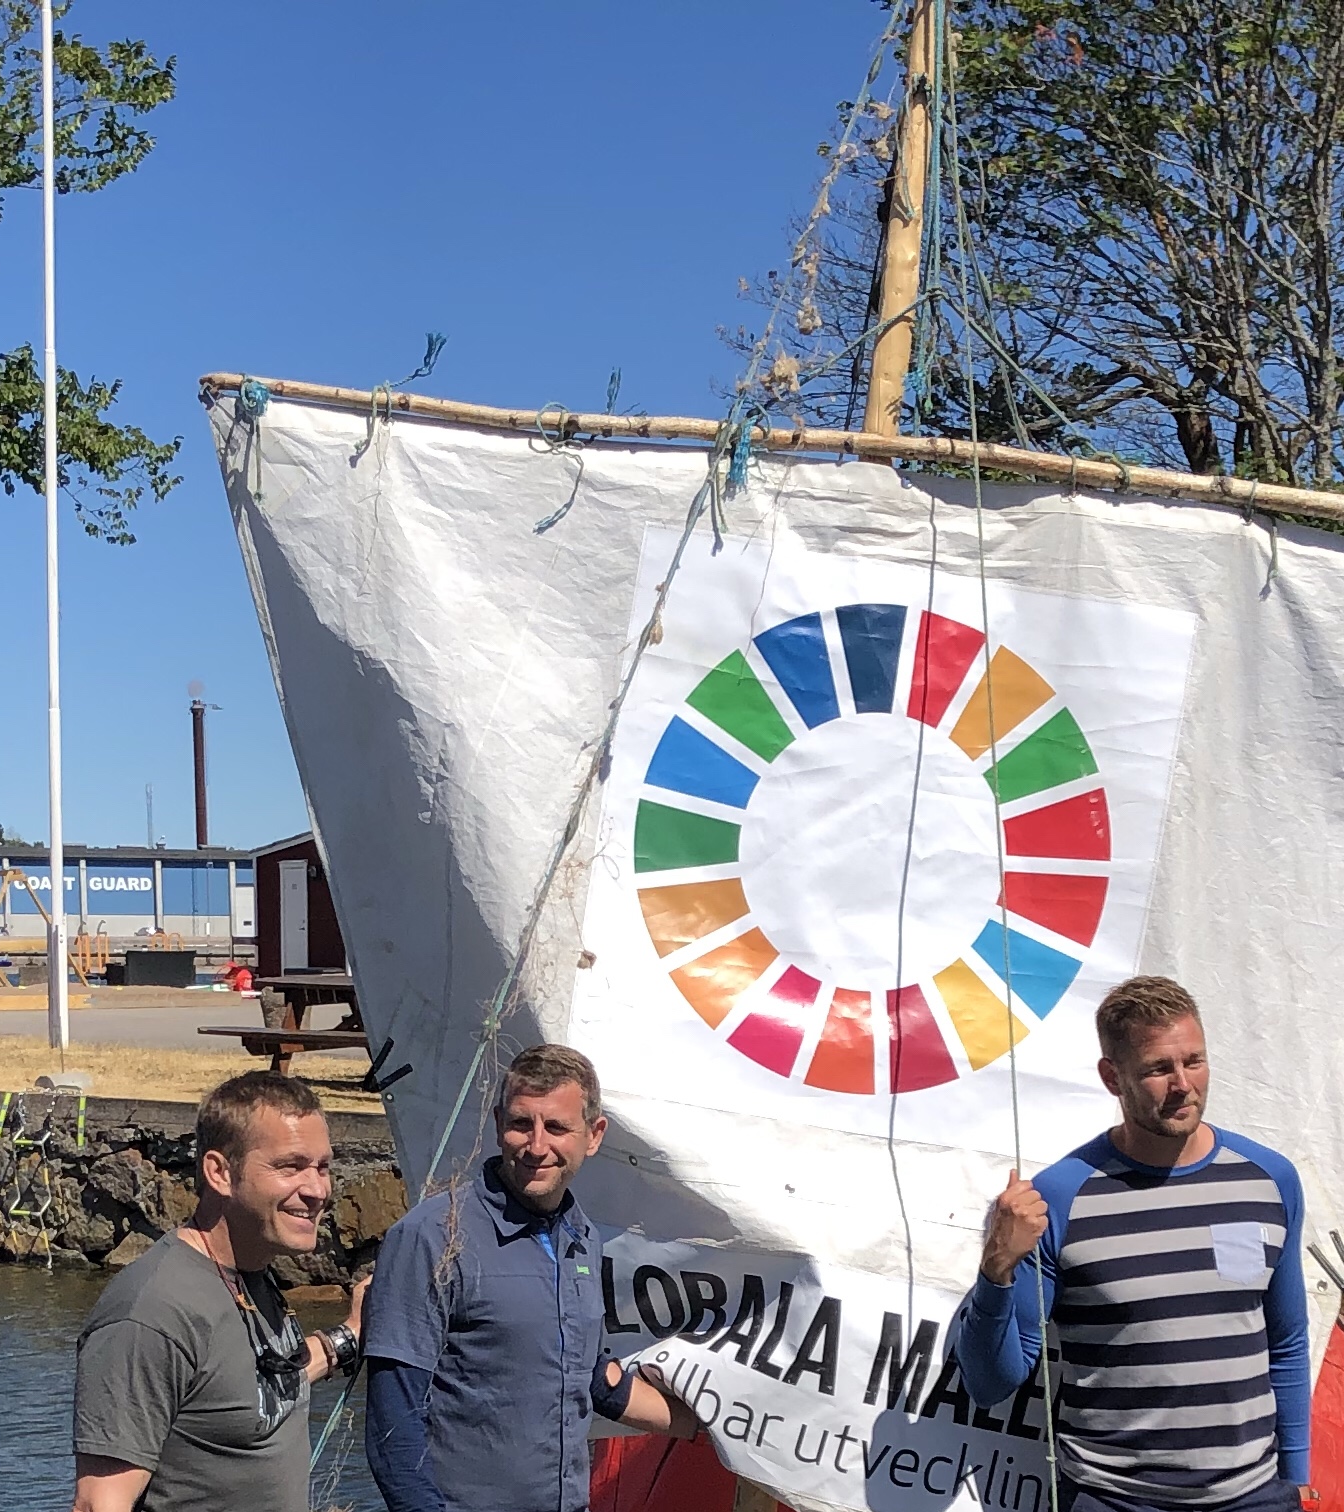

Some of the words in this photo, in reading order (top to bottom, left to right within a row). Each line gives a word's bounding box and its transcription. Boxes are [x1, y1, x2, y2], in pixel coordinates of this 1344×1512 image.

[13, 876, 76, 891] COAT
[89, 876, 153, 891] GUARD
[600, 1255, 842, 1397] LOBALA
